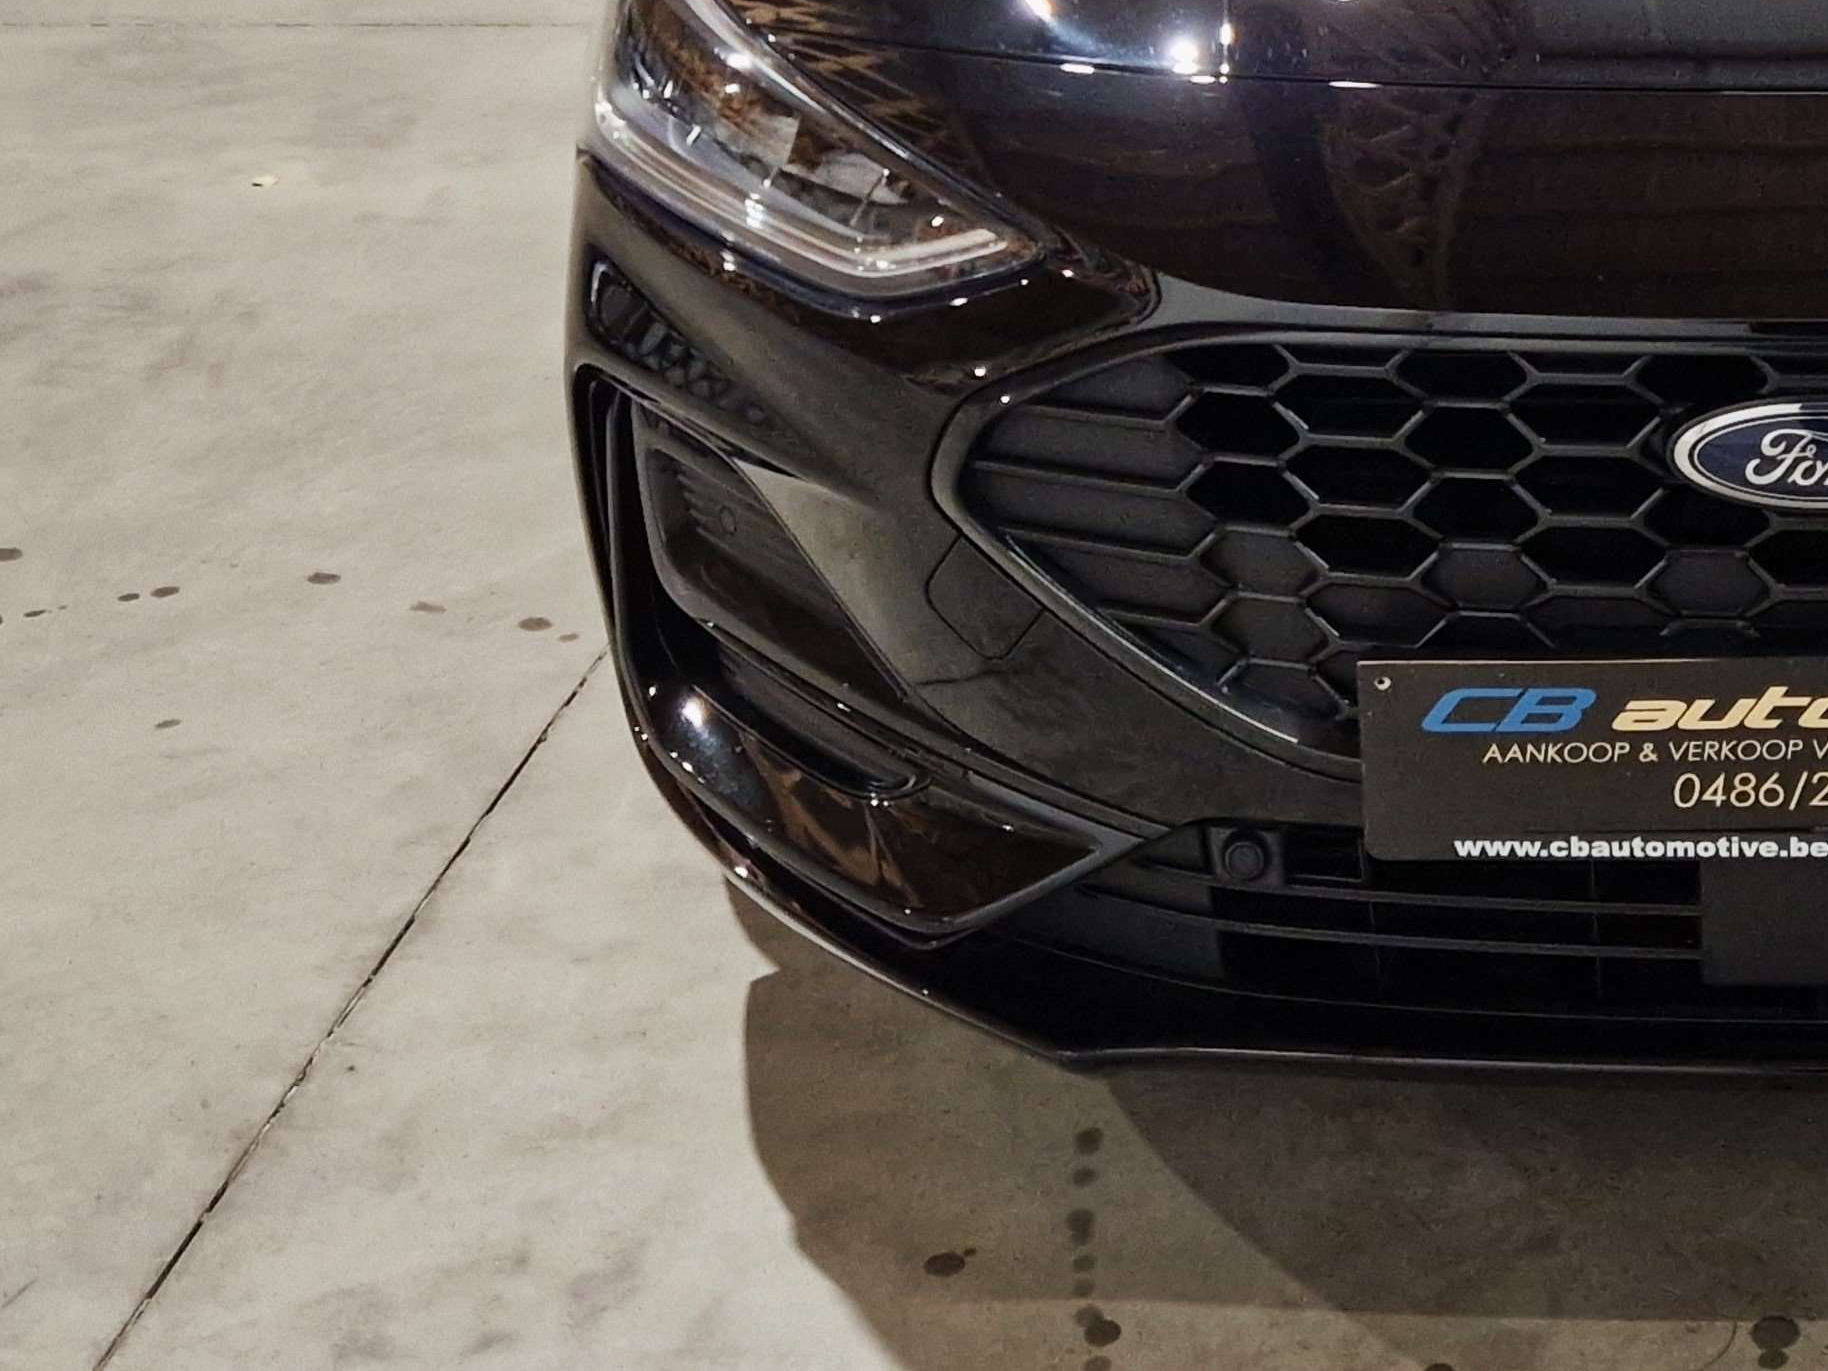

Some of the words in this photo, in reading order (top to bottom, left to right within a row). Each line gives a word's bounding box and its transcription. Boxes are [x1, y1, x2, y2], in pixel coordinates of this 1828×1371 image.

[1421, 686, 1598, 733] CB
[1482, 741, 1631, 764] AANKOOP
[1638, 741, 1659, 763] &
[1668, 739, 1804, 762] VERKOOP
